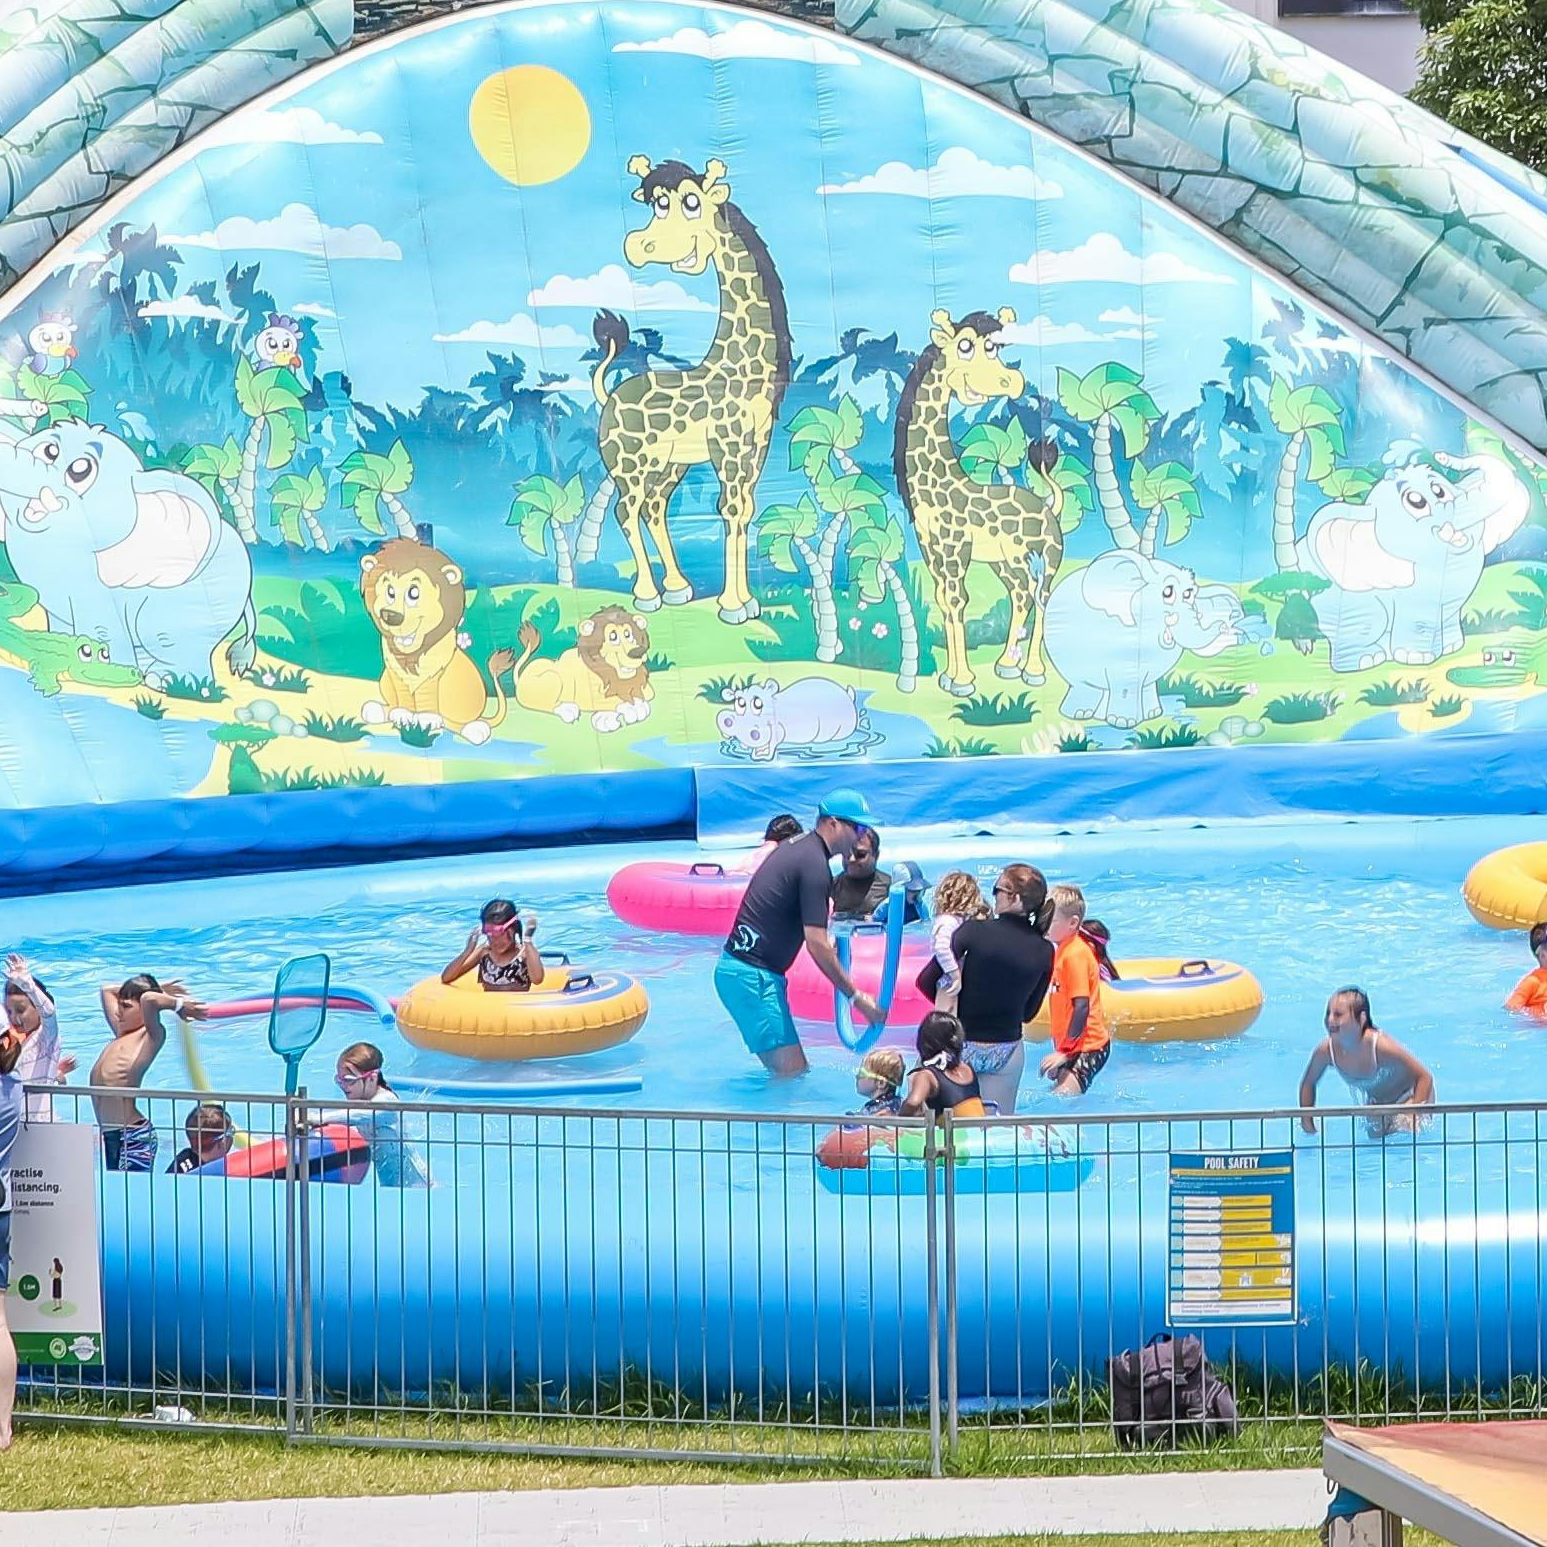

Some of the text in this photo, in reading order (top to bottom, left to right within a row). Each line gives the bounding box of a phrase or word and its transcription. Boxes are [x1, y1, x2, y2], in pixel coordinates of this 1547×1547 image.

[1204, 1156, 1260, 1169] POOL SAFETY
[10, 1167, 44, 1179] ractise
[11, 1182, 62, 1194] istancing.
